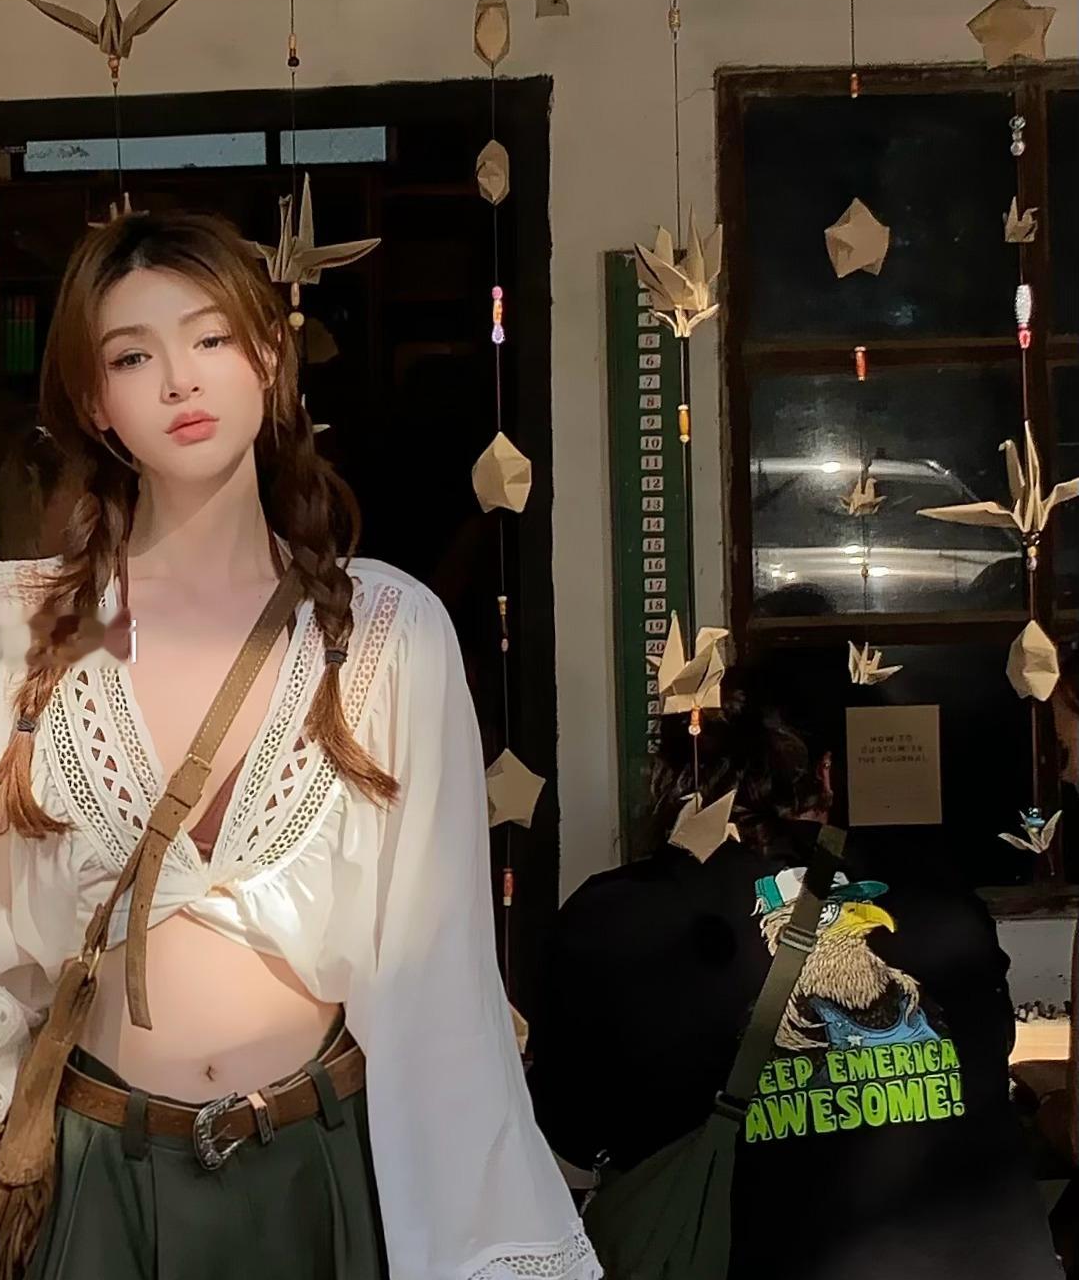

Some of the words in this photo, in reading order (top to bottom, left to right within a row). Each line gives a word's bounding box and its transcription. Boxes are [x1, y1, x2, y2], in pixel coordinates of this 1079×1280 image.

[645, 336, 653, 346] 5
[646, 356, 654, 366] 6
[646, 377, 653, 387] 7
[646, 397, 654, 406] 8
[646, 417, 655, 427] 9
[645, 438, 659, 449] 10
[645, 458, 658, 468] 11
[645, 478, 660, 489] 12
[646, 499, 661, 510] 13
[646, 520, 661, 530] 14
[647, 540, 661, 550] 15
[647, 559, 662, 570] 16
[648, 580, 663, 591] 17
[648, 600, 663, 611] 18
[648, 621, 663, 632] 19
[647, 641, 664, 652] 20
[898, 734, 913, 742] TO
[758, 1056, 813, 1094] EEP
[826, 1038, 961, 1085] EMERICA
[745, 1073, 965, 1143] AWESOME!
